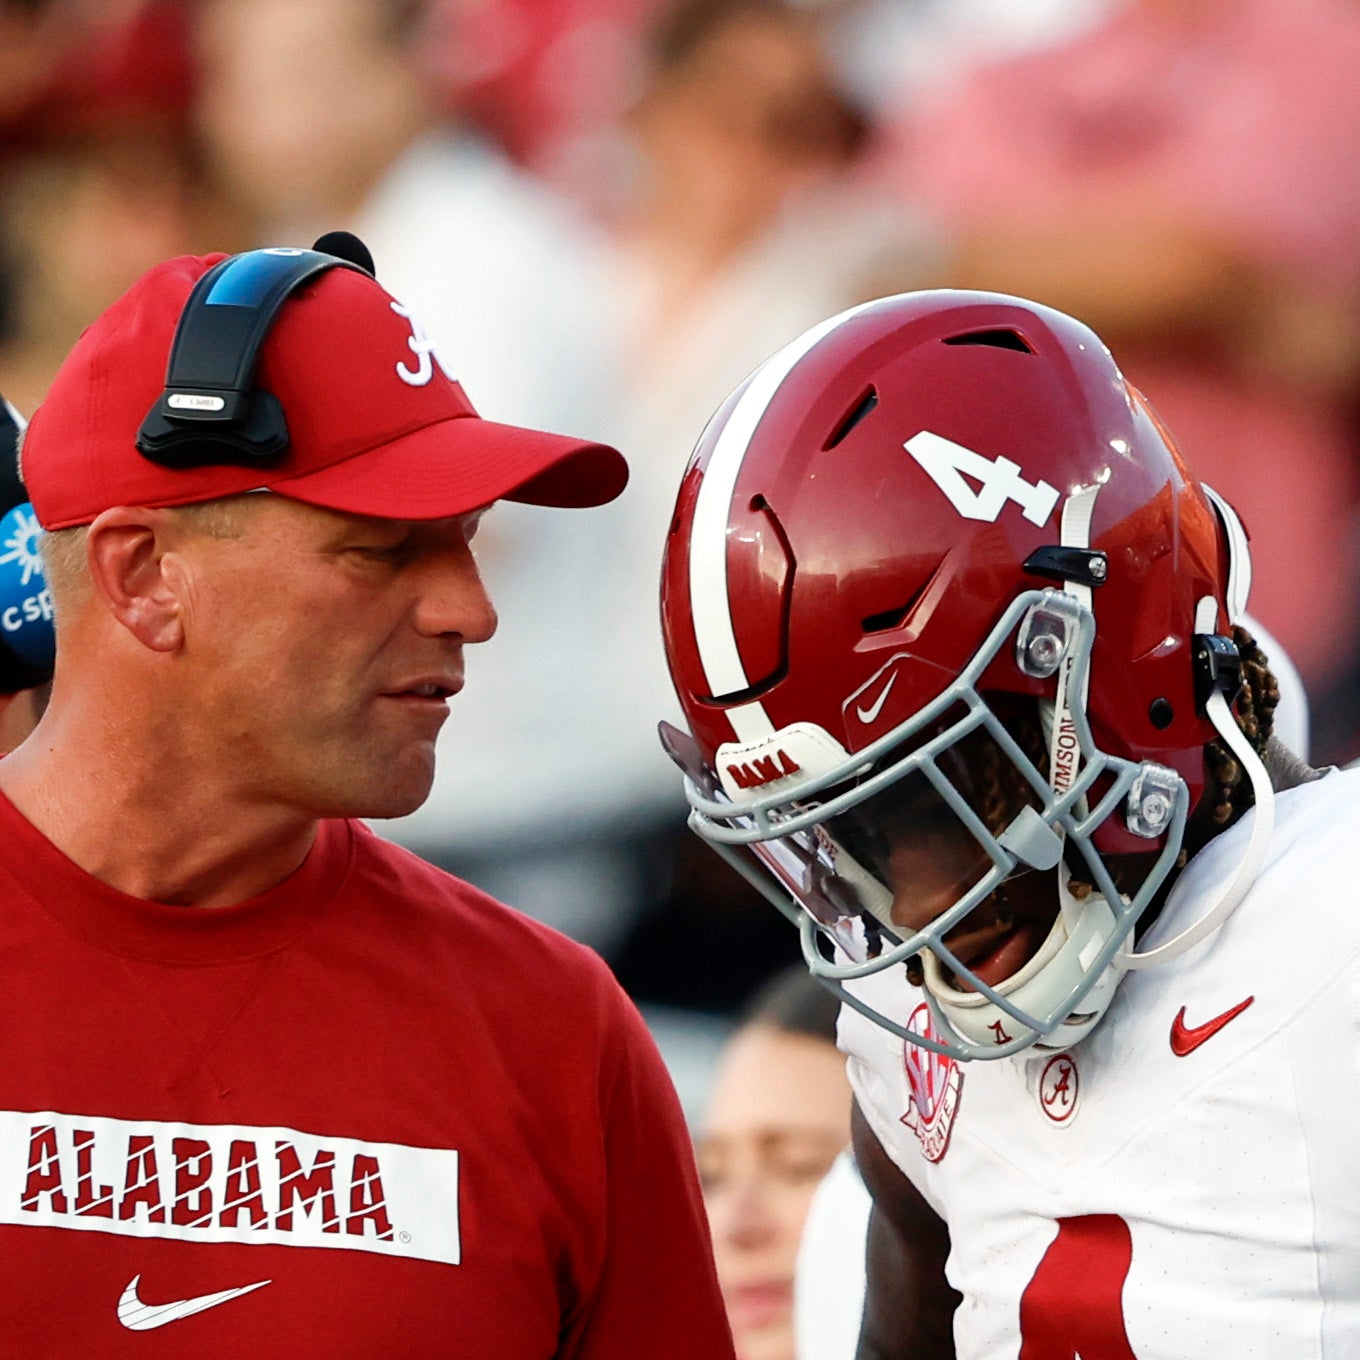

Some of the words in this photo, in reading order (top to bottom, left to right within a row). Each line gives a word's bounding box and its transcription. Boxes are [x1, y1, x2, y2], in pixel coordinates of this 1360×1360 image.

[902, 429, 1061, 529] 4
[726, 748, 801, 790] BAMA
[1044, 1063, 1072, 1106] A
[20, 1124, 394, 1242] ALABAMA
